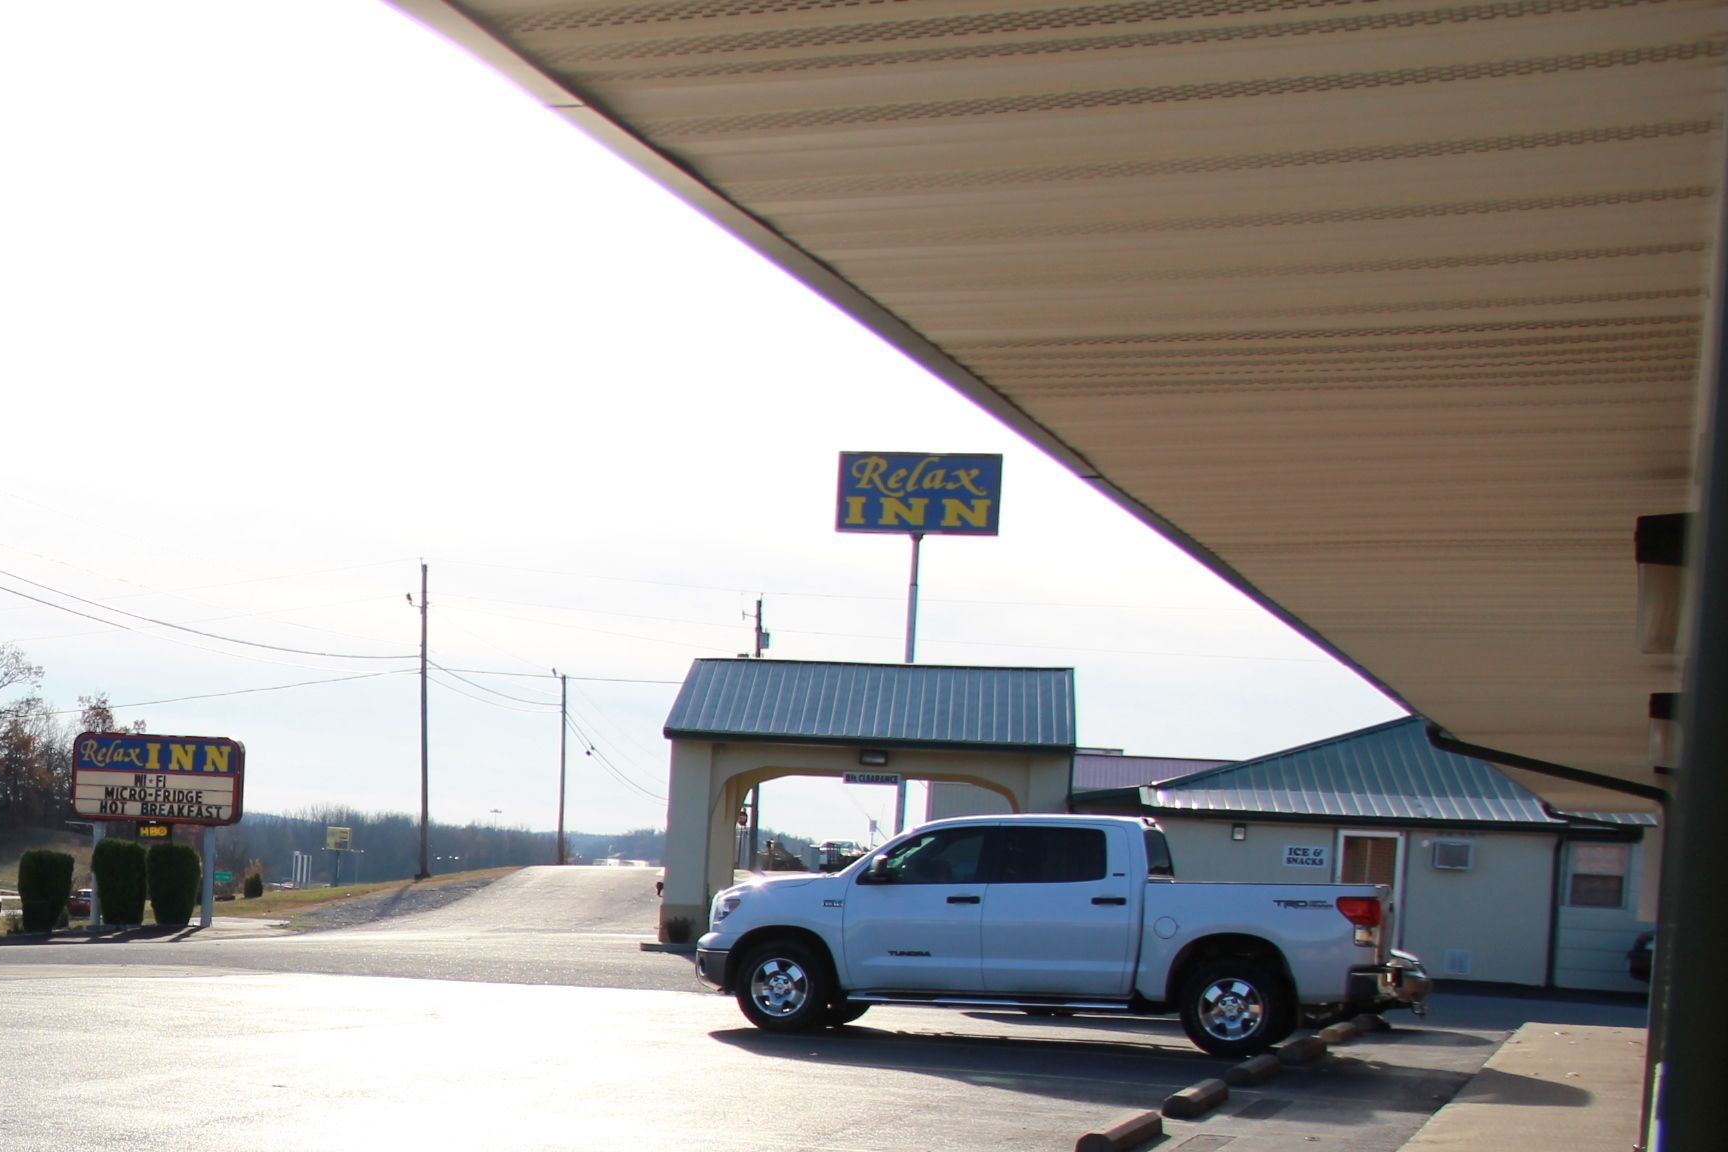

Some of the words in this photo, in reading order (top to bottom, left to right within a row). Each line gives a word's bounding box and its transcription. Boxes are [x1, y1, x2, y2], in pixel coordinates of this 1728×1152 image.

[851, 455, 987, 497] Relax
[845, 496, 992, 527] INN
[80, 739, 144, 767] Relax
[145, 743, 231, 772] INN
[104, 787, 203, 804] MICRO-FRIDGE
[100, 801, 127, 815] HOT
[140, 803, 223, 820] BREAKFAST
[139, 826, 168, 837] HBO
[1288, 847, 1310, 857] ICE
[1286, 857, 1324, 866] SNACKS
[1273, 899, 1308, 909] TRD
